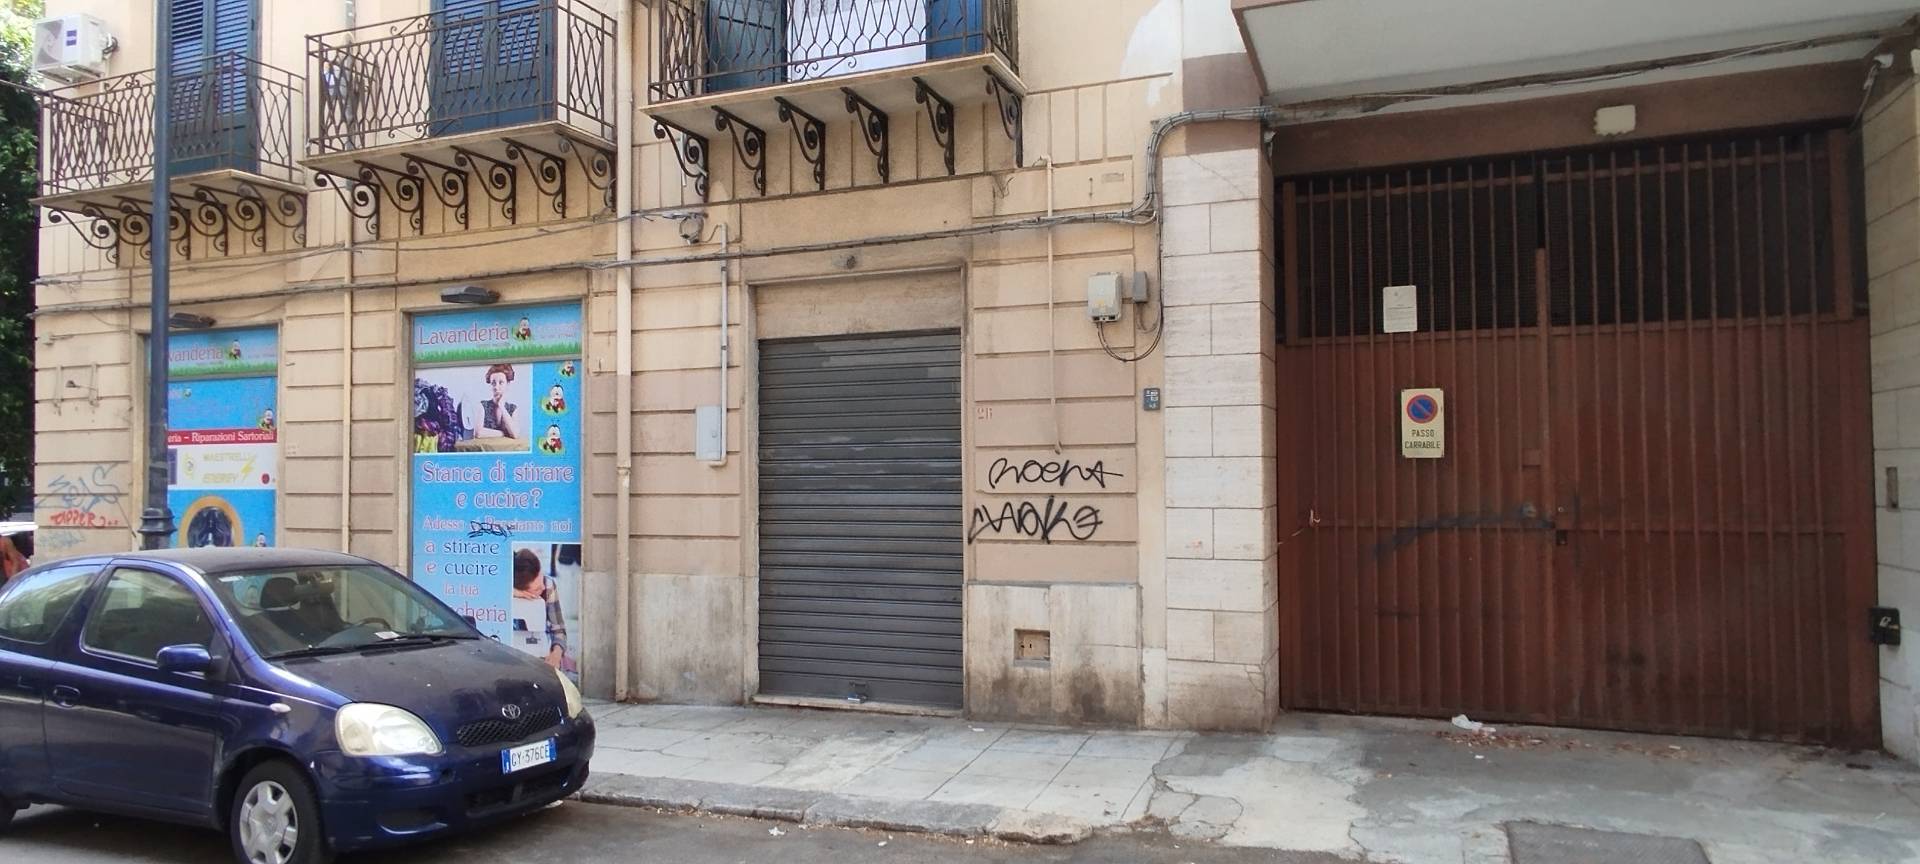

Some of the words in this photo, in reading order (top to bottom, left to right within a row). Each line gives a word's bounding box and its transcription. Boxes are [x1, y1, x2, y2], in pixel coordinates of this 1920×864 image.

[418, 322, 509, 346] Lavanderia
[168, 342, 224, 361] vanderia
[191, 431, 236, 443] Riparazioni
[1412, 429, 1435, 437] PASSO
[1404, 440, 1441, 449] CARRABILE
[422, 460, 484, 484] Stanca
[489, 460, 507, 484] di
[513, 461, 574, 484] stirare
[455, 491, 468, 508] e
[474, 487, 544, 509] cucire?
[424, 541, 436, 553] a
[442, 539, 500, 555] stirare
[425, 562, 437, 574] e
[444, 561, 498, 576] cucire
[444, 582, 455, 595] la
[460, 583, 480, 596] tua
[456, 601, 507, 623] cheria
